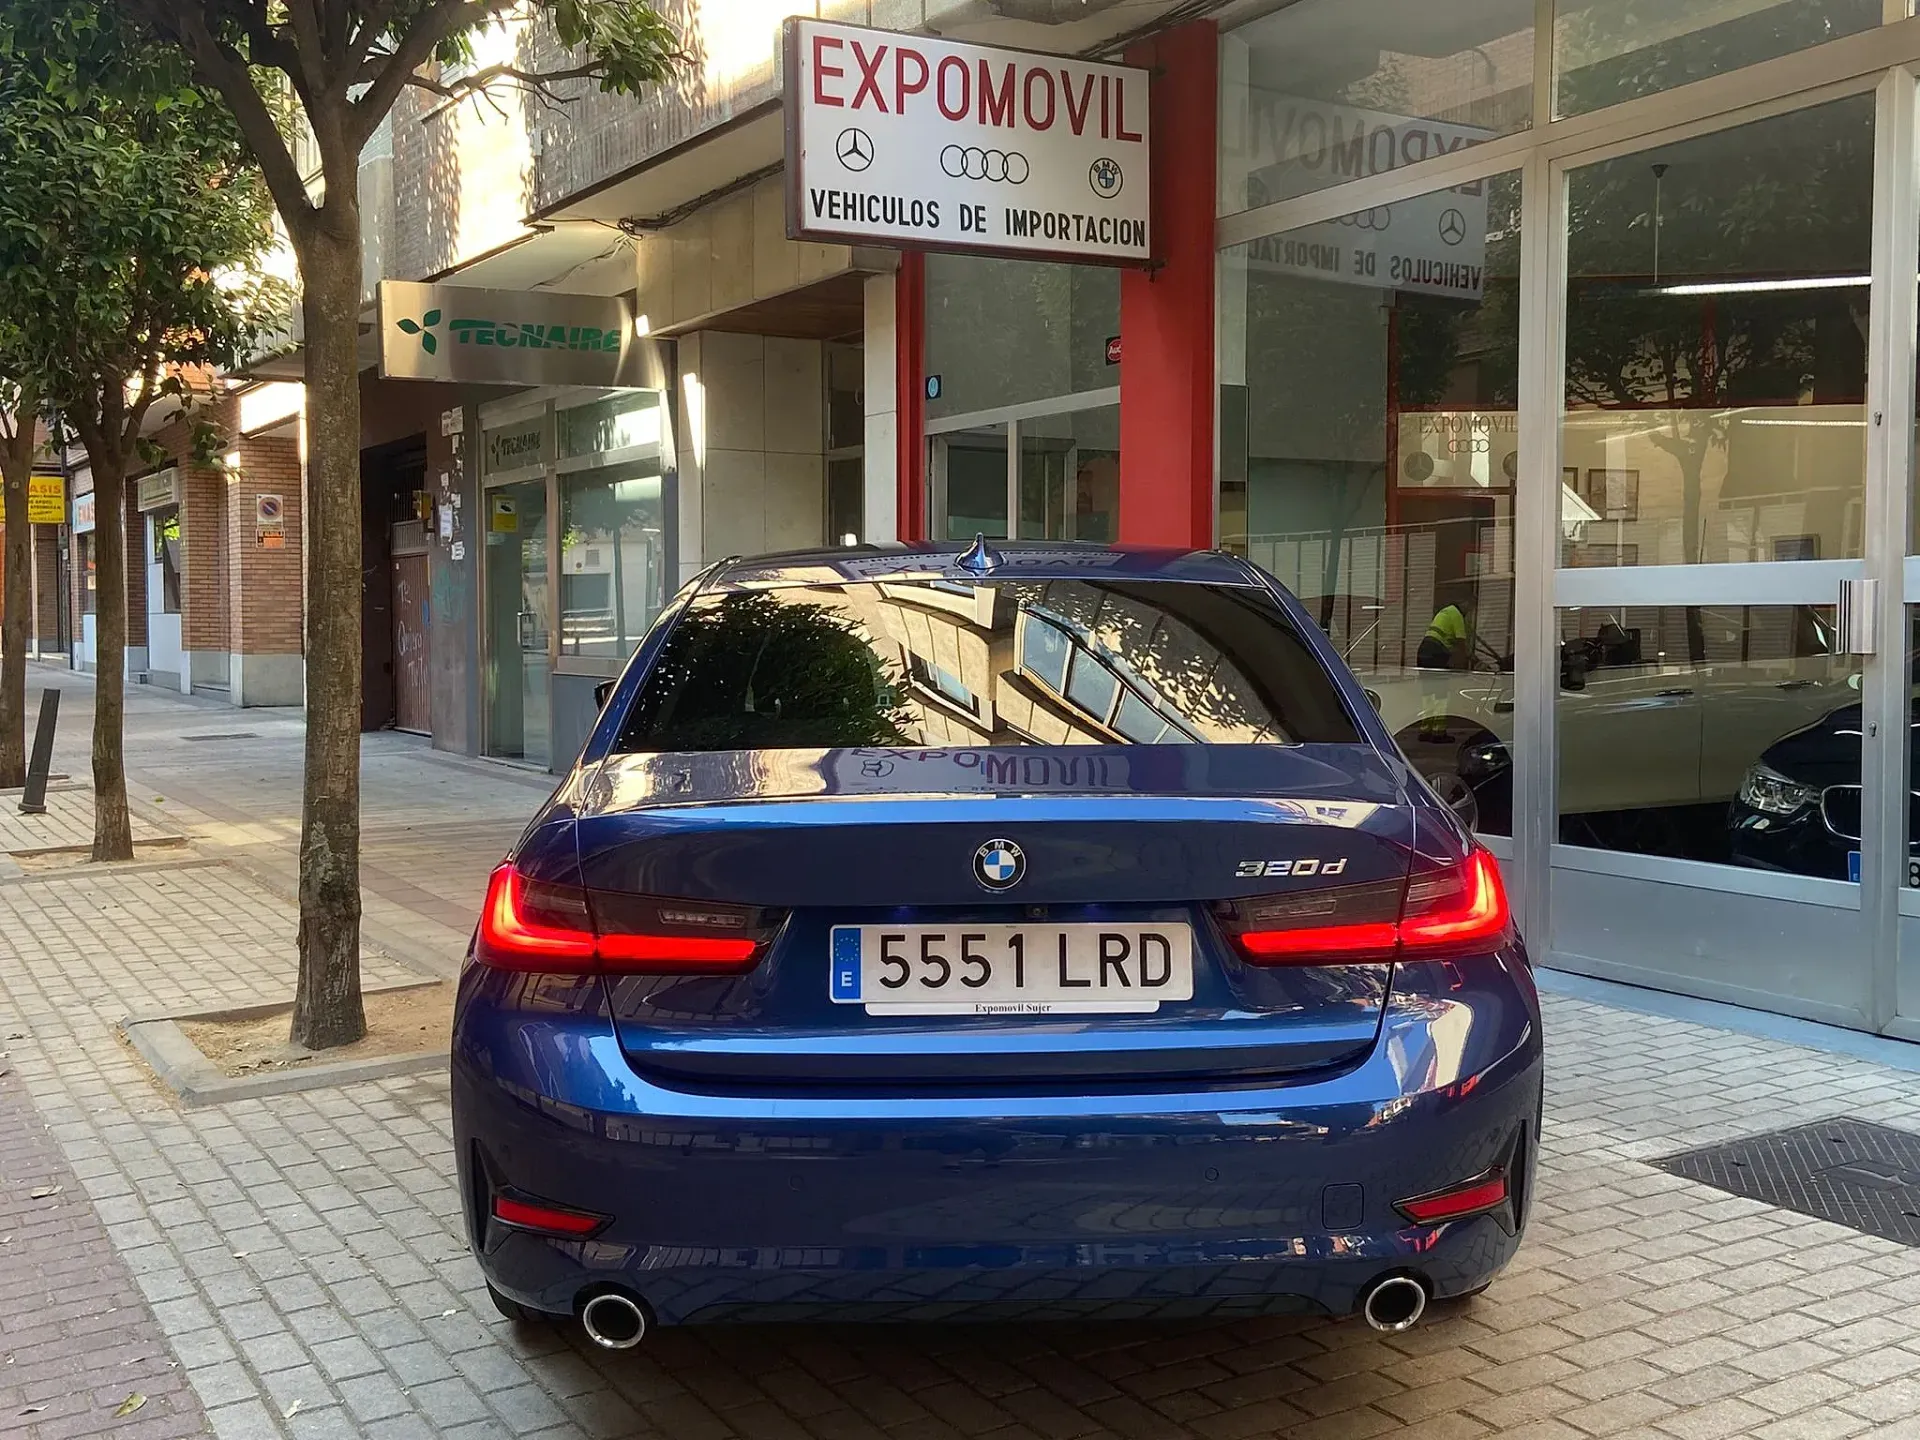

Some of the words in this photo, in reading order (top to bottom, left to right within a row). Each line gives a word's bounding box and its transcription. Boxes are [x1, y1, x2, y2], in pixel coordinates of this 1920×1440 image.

[812, 35, 1143, 143] EXPOMOVIL
[810, 188, 940, 229] VEHICULOS
[960, 204, 987, 234] DE
[1005, 208, 1145, 248] IMPORTACION
[449, 319, 621, 352] TECNAIRE
[1420, 415, 1518, 434] EXPOMOVIL
[851, 749, 1126, 787] EXPOMOVIL
[1235, 857, 1348, 878] 320d
[879, 933, 1024, 989] 5551
[1059, 932, 1171, 988] LRD
[841, 971, 853, 987] E
[975, 1003, 1024, 1015] Expomovil
[1026, 1003, 1052, 1015] Sujer
